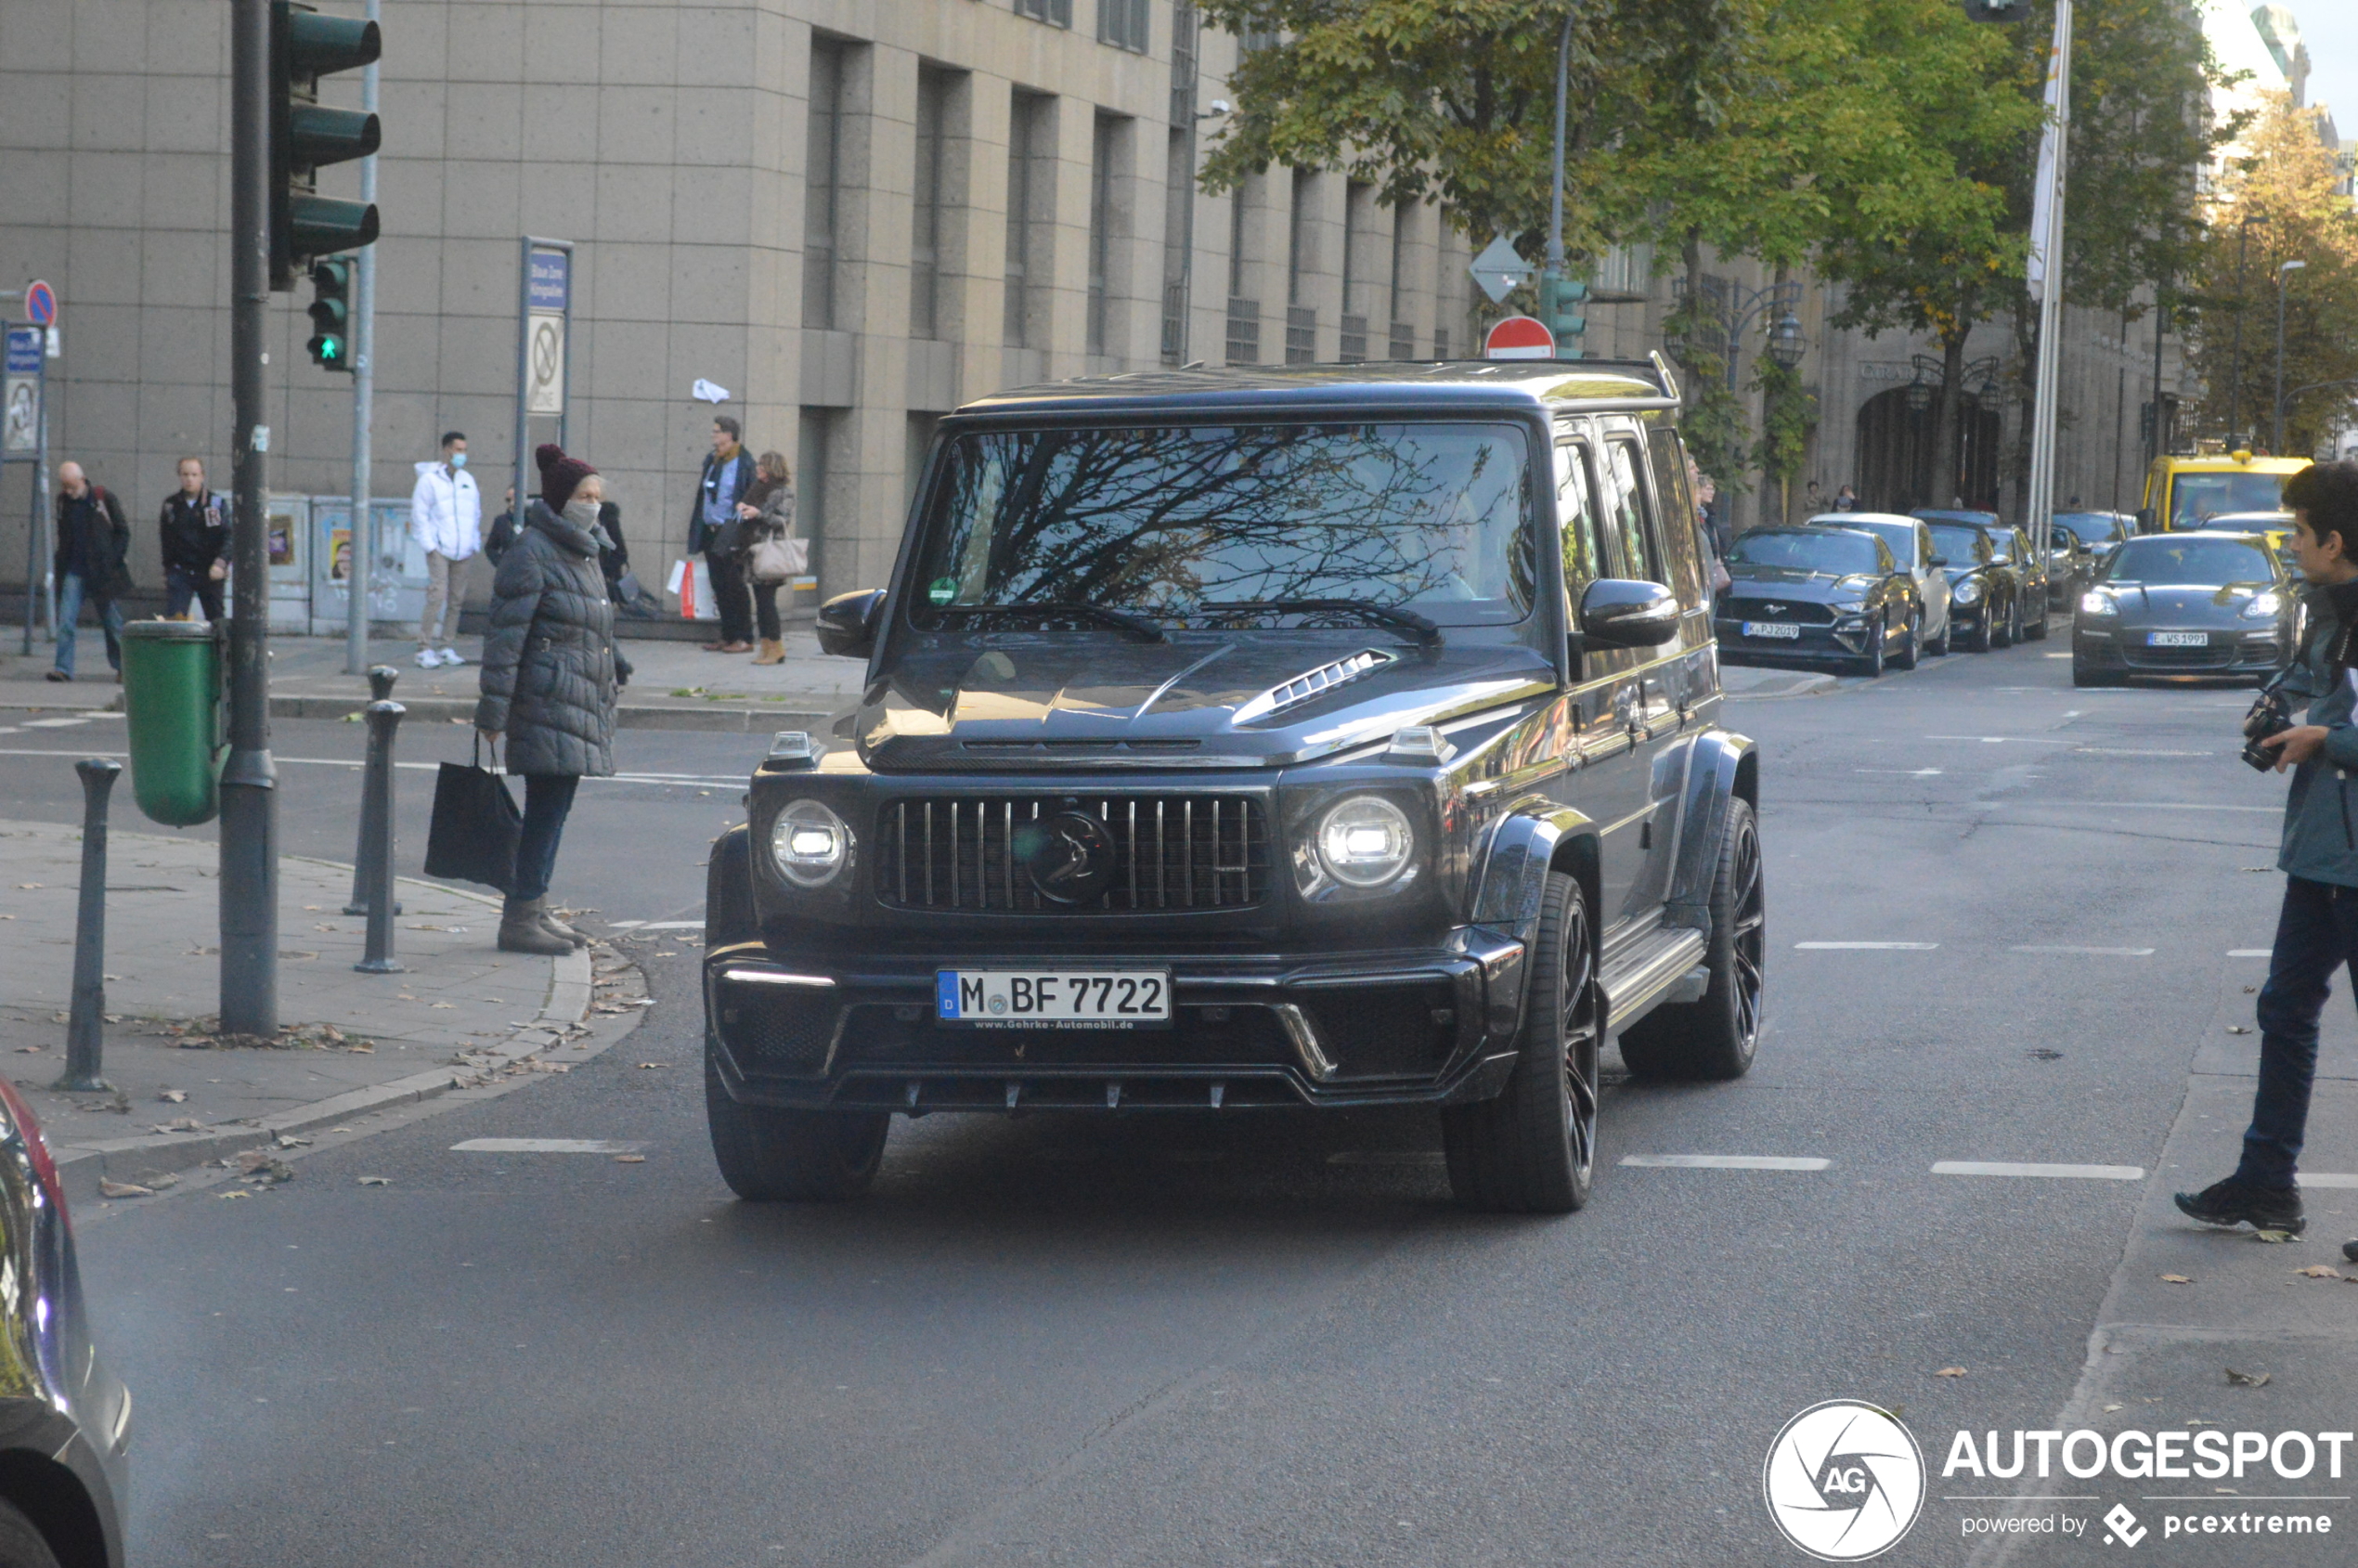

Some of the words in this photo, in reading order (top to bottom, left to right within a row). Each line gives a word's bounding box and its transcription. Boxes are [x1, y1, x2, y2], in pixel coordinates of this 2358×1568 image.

[961, 978, 984, 1012] M
[1011, 978, 1058, 1012] BF
[1069, 978, 1162, 1013] 7722
